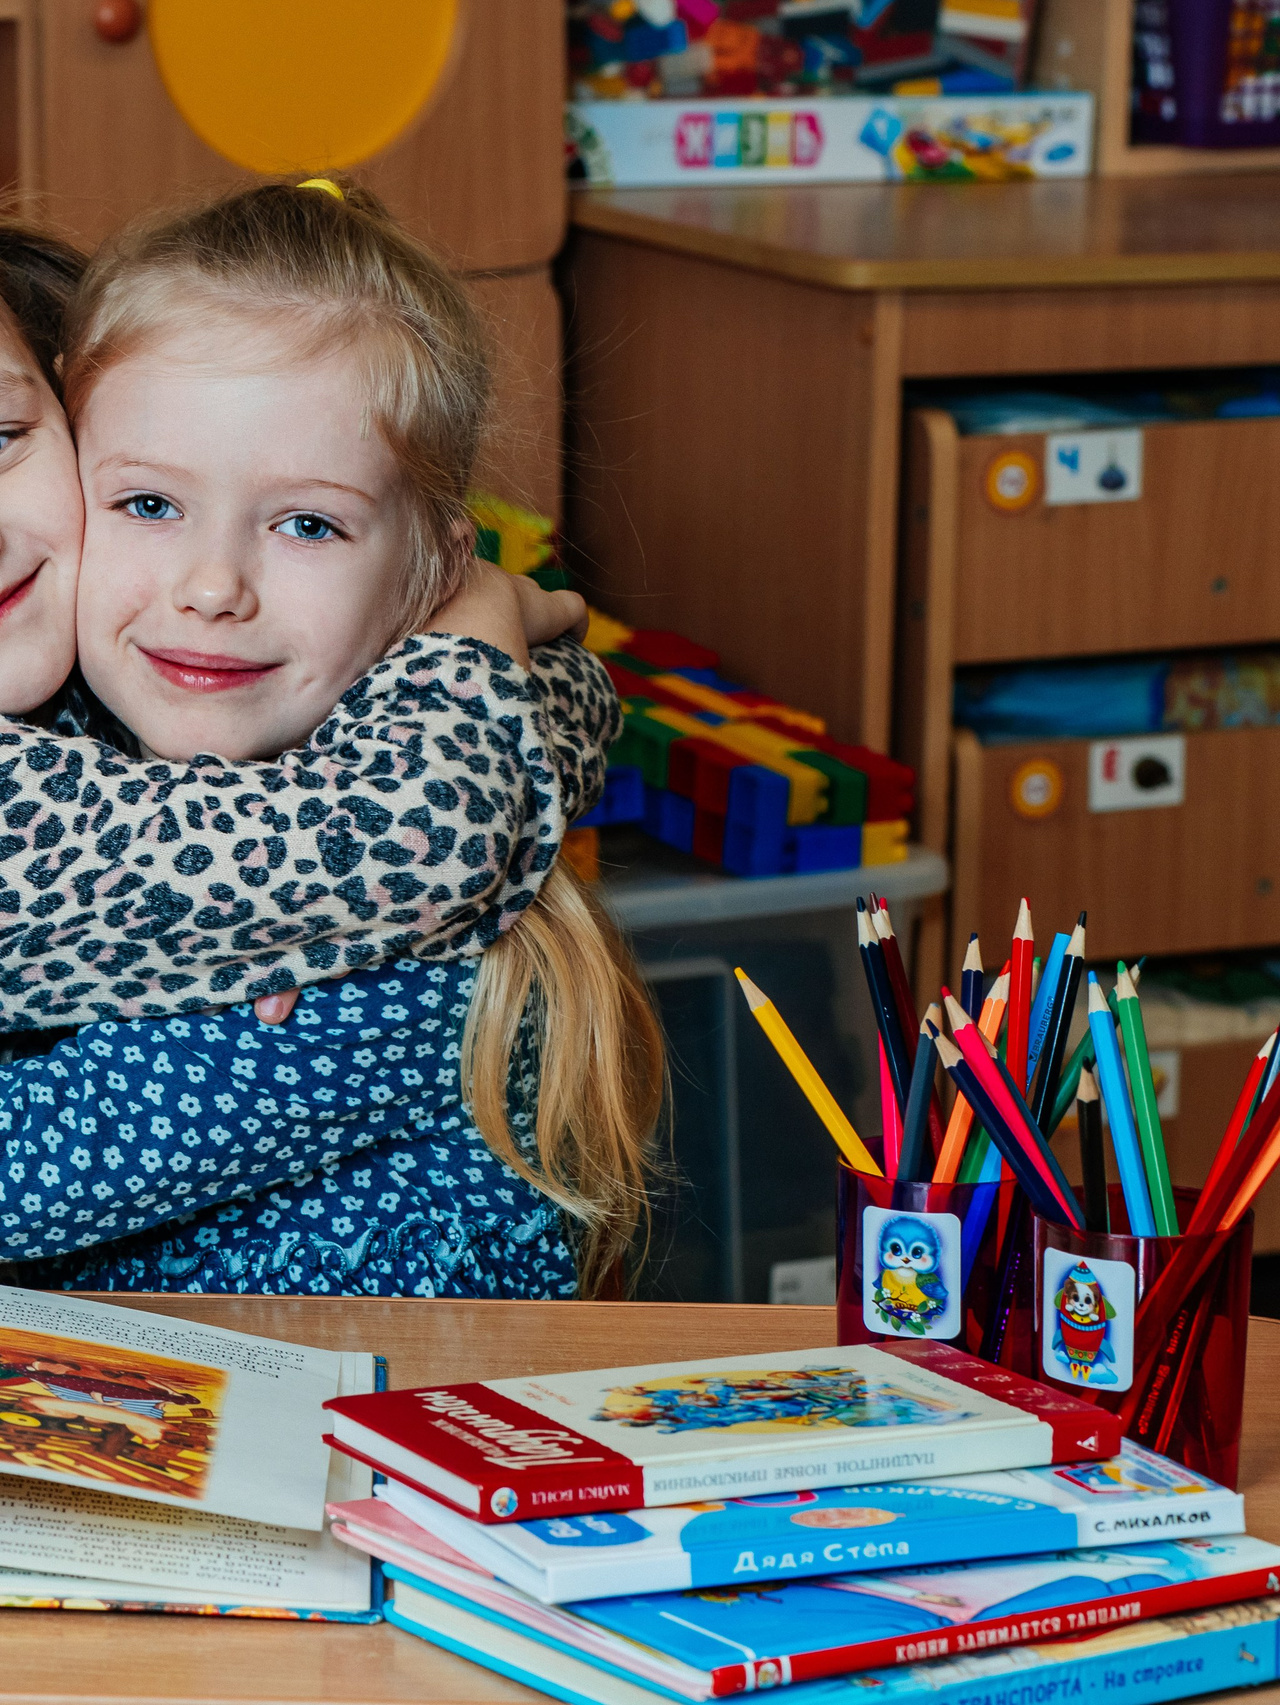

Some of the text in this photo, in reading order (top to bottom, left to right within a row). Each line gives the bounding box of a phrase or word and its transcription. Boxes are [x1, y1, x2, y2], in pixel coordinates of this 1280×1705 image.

[652, 1468, 766, 1492] ПРИКЛЮЧЕНИЯ
[774, 1462, 827, 1479] НОВЫЕ
[531, 1483, 630, 1506] МАЙКЛ БОНД
[732, 1539, 911, 1575] Дядя Стёпа
[895, 1601, 1142, 1663] КОННИ ЗАНИМАЕТСЯ ТАНЦАМИ
[1103, 1670, 1127, 1690] На
